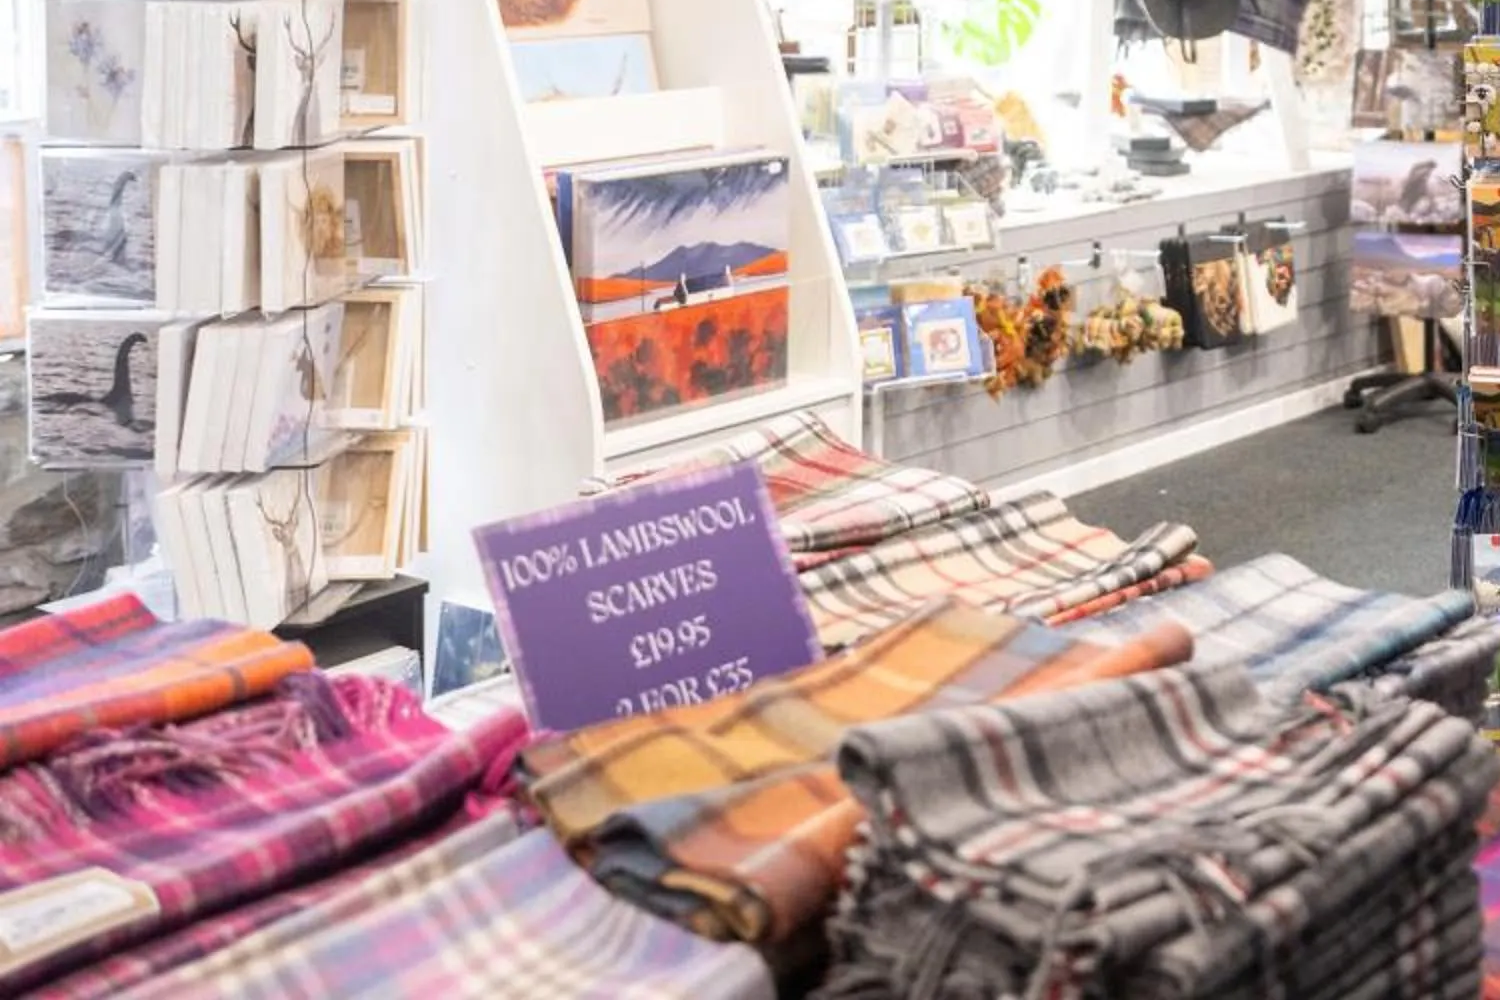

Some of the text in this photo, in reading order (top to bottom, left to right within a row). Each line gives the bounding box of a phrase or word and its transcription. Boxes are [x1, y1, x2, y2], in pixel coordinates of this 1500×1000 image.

[501, 497, 756, 593] 100% LAMBSWOOL
[587, 559, 719, 624] SCARVES
[629, 615, 712, 670] £19.95
[639, 675, 702, 716] FOR
[706, 656, 754, 696] £35
